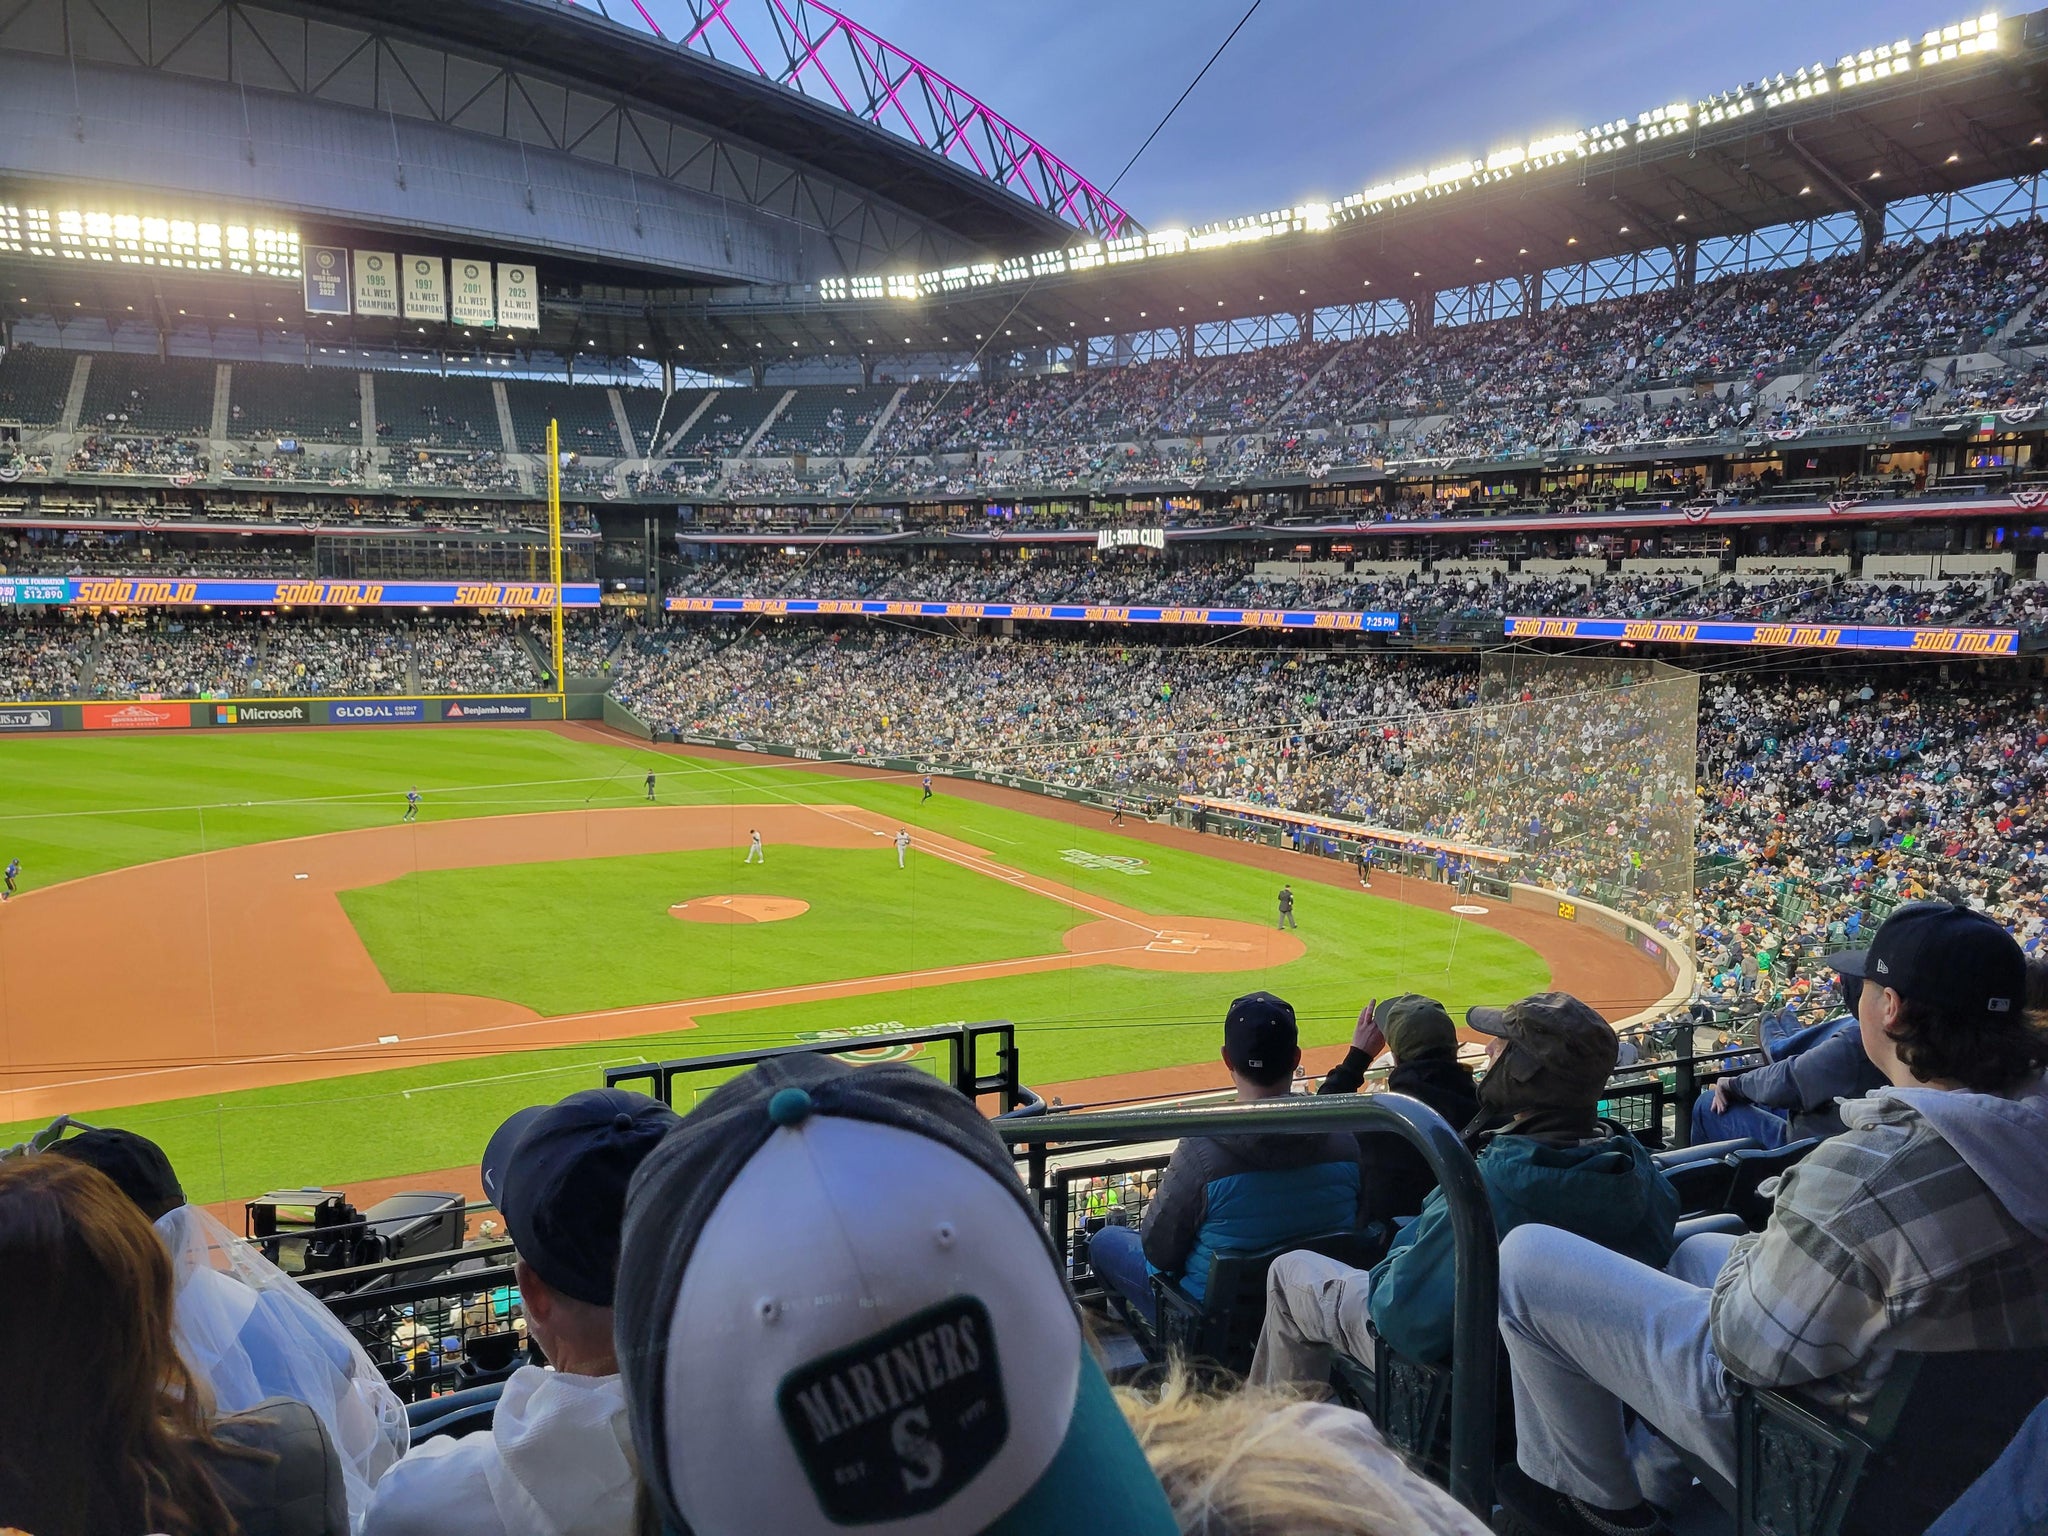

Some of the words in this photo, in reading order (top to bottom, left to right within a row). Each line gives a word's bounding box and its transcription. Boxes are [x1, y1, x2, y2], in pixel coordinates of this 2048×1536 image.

[366, 275, 386, 286] 1995
[415, 279, 432, 290] 1997
[362, 288, 373, 297] A.L.
[374, 288, 391, 298] WEST
[463, 283, 481, 293] 2001
[509, 287, 526, 298] 2025
[410, 292, 420, 300] A.L.
[422, 293, 439, 302] WEST
[458, 296, 469, 304] A.L.
[470, 296, 487, 306] WEST
[358, 300, 396, 311] CHAMPIONS
[406, 303, 443, 314] CHAMPIONS
[505, 300, 515, 309] A.L.
[516, 301, 531, 309] WEST
[455, 307, 491, 318] CHAMPIONS
[501, 311, 535, 321] CHAMPIONS
[1140, 528, 1164, 549] CLUB
[1366, 617, 1382, 627] 7:25
[1384, 618, 1395, 627] PM
[240, 707, 303, 720] Microsoft
[336, 707, 392, 717] GLOBAL
[464, 706, 499, 716] Benjamin
[500, 706, 525, 714] Moore
[794, 748, 821, 760] STIHL
[926, 766, 954, 775] LEXUS
[796, 1315, 981, 1444] MARINERS
[891, 1404, 944, 1493] S
